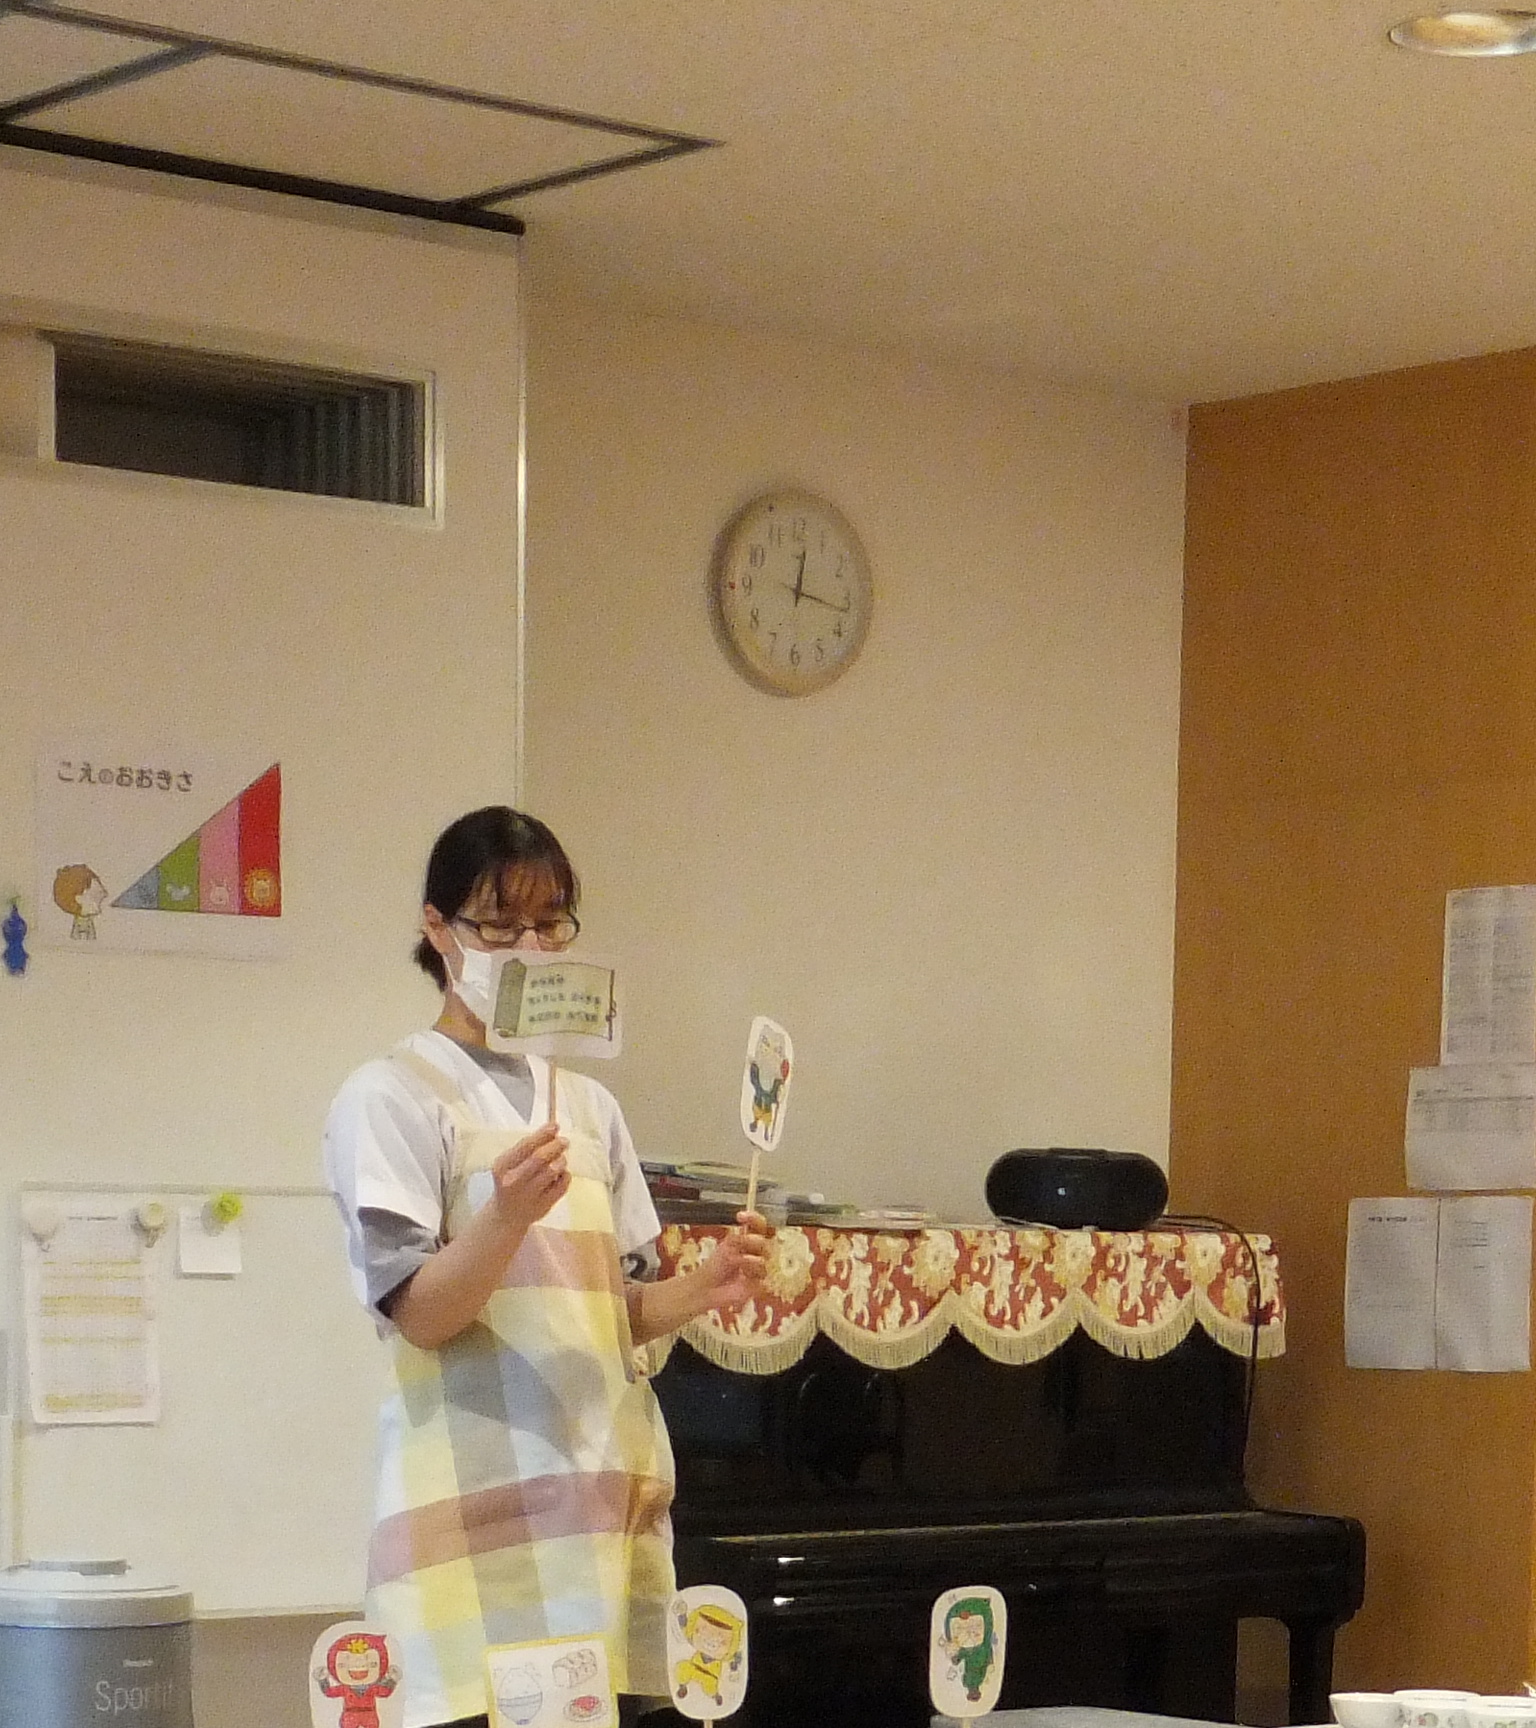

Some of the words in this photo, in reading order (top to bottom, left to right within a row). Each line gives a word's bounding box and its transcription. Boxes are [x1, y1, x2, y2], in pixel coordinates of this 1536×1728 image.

[741, 573, 753, 596] 9
[57, 760, 194, 792] こえのおおきさ
